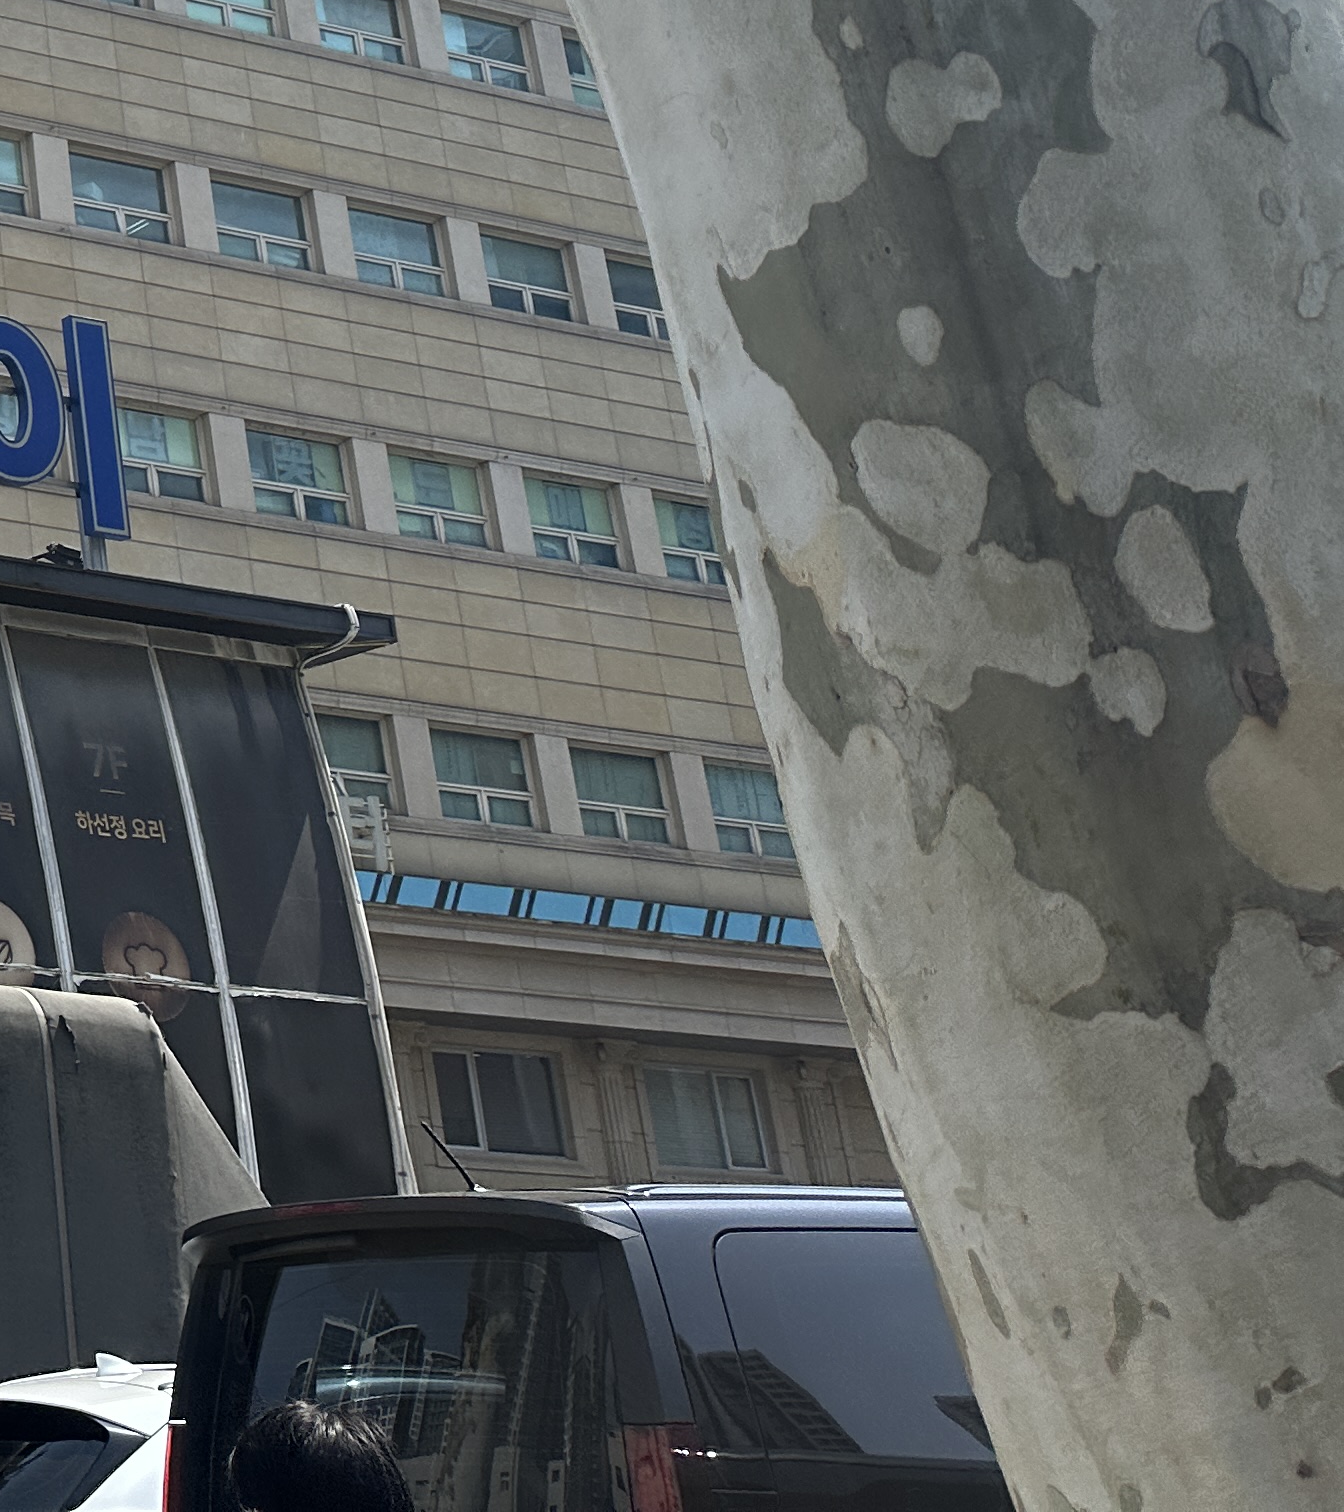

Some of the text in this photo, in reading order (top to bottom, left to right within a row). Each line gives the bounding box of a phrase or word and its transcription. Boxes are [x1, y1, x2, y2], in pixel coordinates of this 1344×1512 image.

[82, 741, 129, 782] 7F
[75, 809, 167, 845] 하선정 요리
